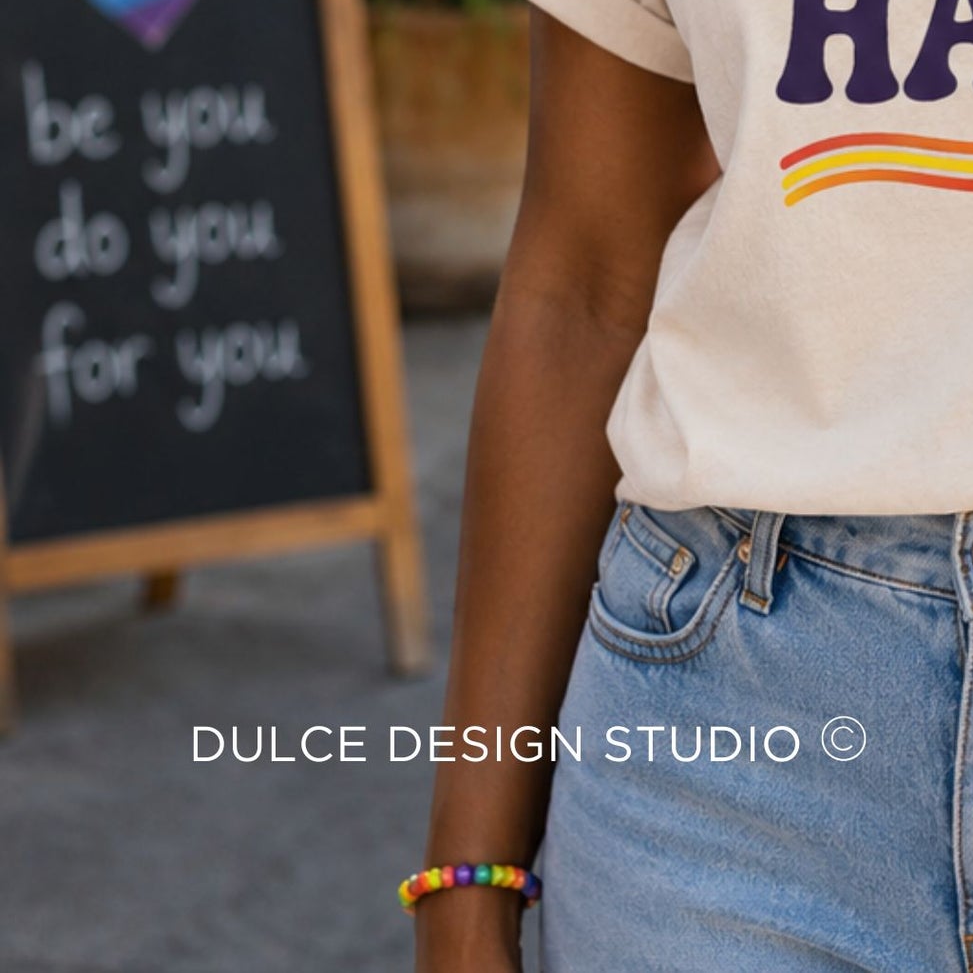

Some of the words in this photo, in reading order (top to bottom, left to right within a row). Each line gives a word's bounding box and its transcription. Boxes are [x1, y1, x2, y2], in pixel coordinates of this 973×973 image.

[22, 61, 121, 164] be
[141, 85, 275, 194] you
[35, 179, 130, 281] do
[149, 201, 283, 309] you
[36, 301, 153, 423] for
[176, 320, 310, 432] you
